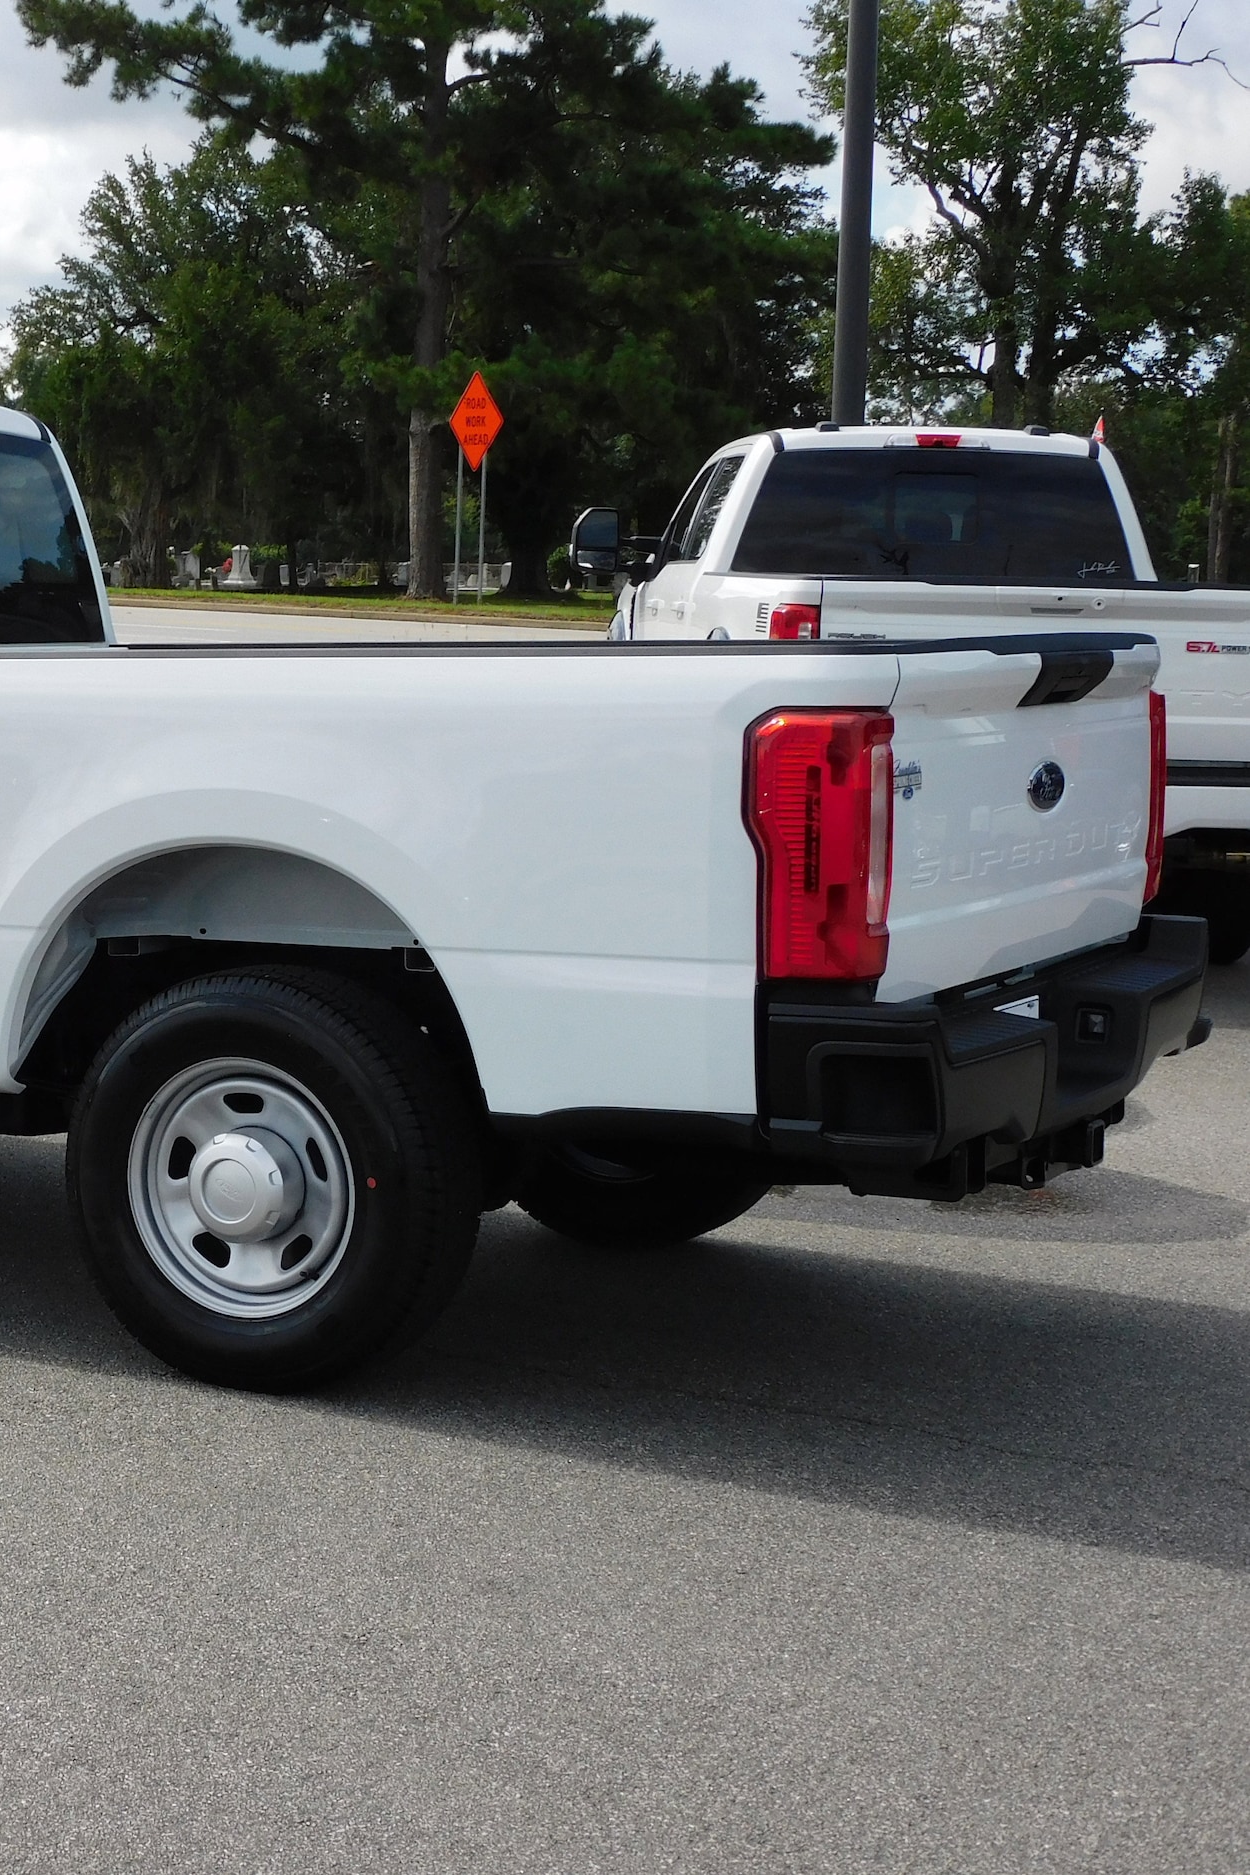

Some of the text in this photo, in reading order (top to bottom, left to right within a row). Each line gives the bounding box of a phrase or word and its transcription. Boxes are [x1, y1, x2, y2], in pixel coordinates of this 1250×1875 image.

[466, 397, 486, 409] ROAD
[466, 415, 486, 427] WORK
[463, 433, 489, 446] AHEAD
[1186, 641, 1220, 653] 6.7L
[910, 815, 1143, 889] SUPER DUTY
